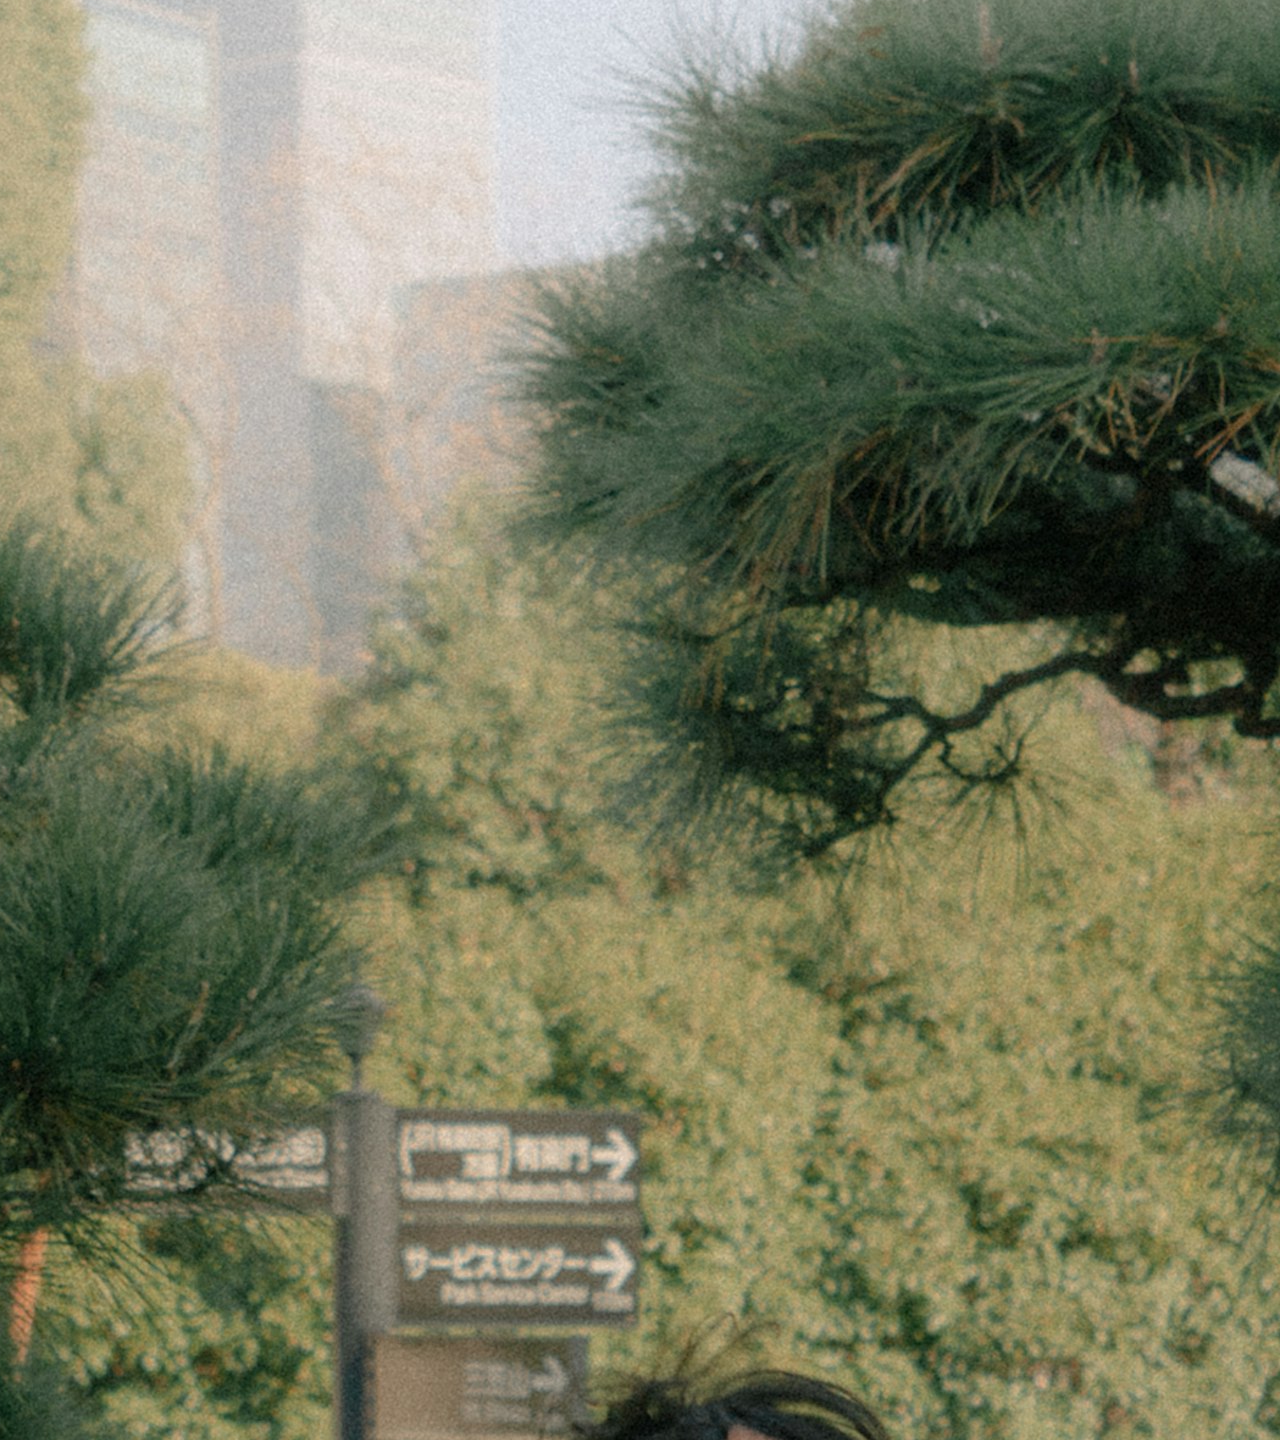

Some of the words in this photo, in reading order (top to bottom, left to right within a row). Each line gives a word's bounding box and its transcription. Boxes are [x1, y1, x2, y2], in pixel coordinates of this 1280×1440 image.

[404, 1244, 587, 1280] サービスセンター
